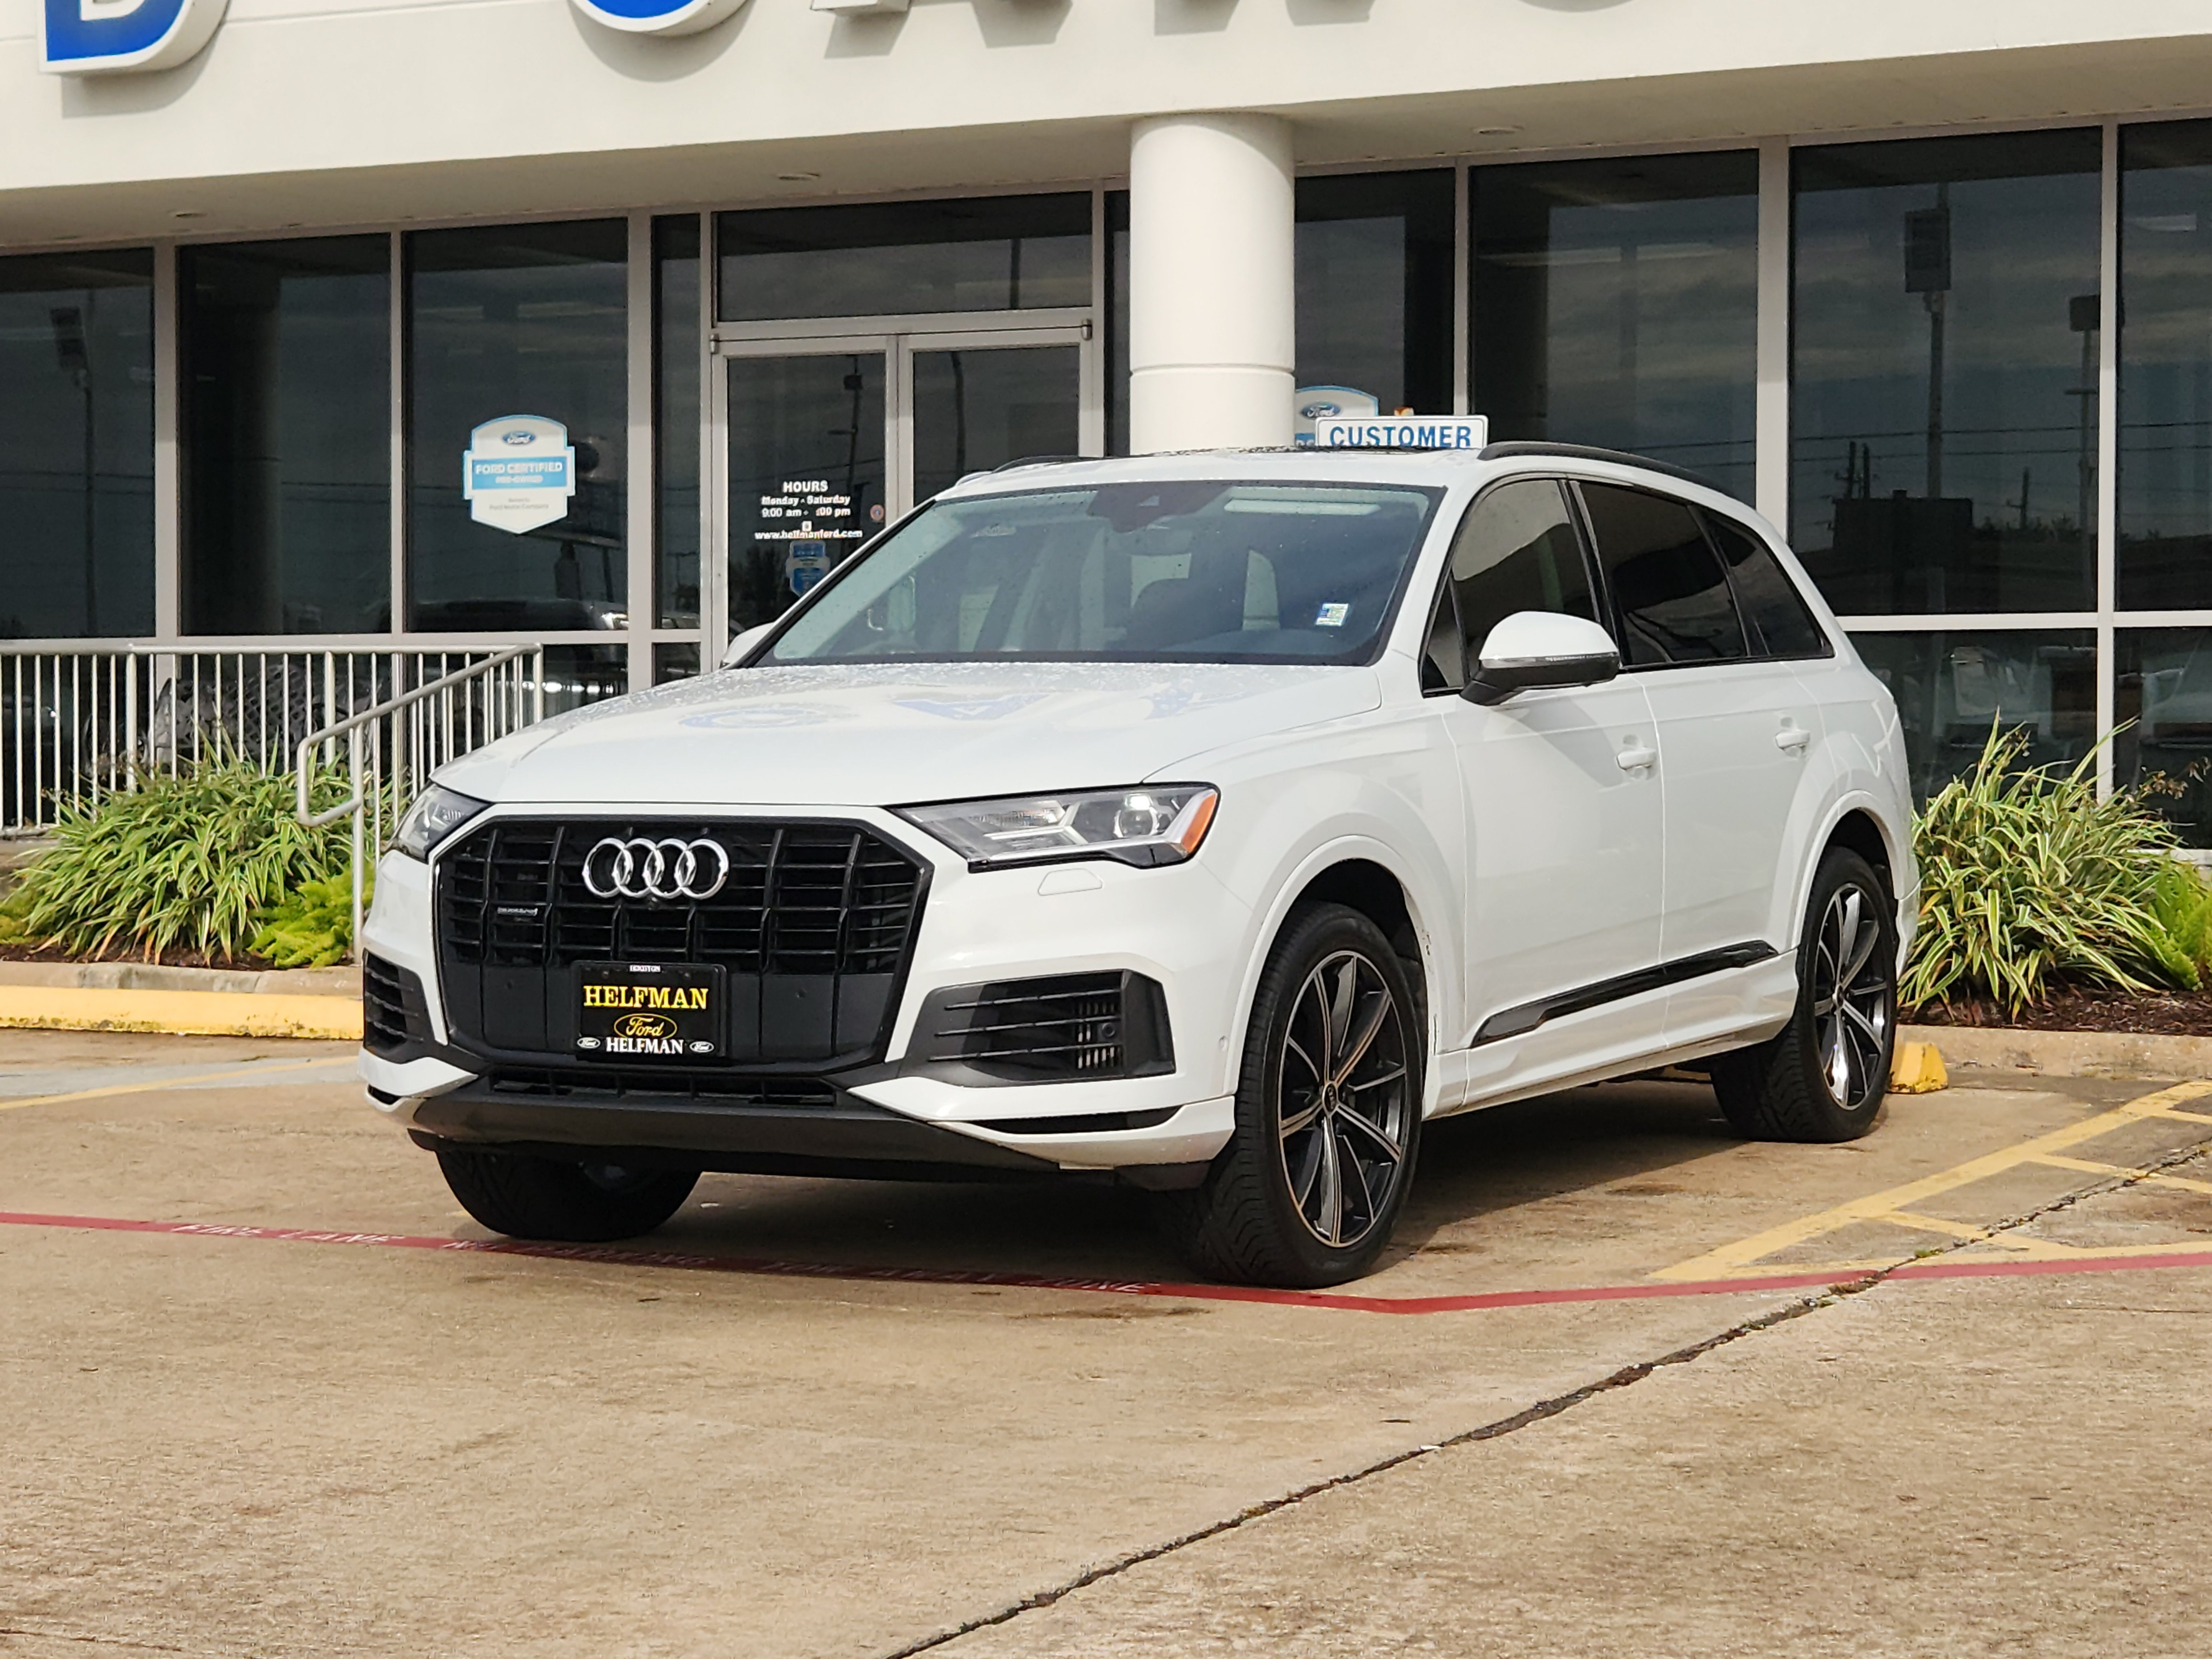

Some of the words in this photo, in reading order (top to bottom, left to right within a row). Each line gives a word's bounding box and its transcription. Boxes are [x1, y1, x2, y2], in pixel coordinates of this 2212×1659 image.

[1307, 406, 1334, 417] Ford
[1330, 426, 1471, 448] CUSTOMER
[476, 463, 505, 474] FORD
[507, 462, 563, 474] CERTIFIED
[782, 480, 828, 493] HOURS
[761, 496, 800, 506] Monday
[807, 495, 851, 506] Saturday
[786, 508, 802, 517] am
[834, 508, 851, 518] pm
[583, 985, 709, 1010] HELFMAN
[626, 1016, 665, 1036] Ford
[606, 1036, 685, 1055] HELFMAN
